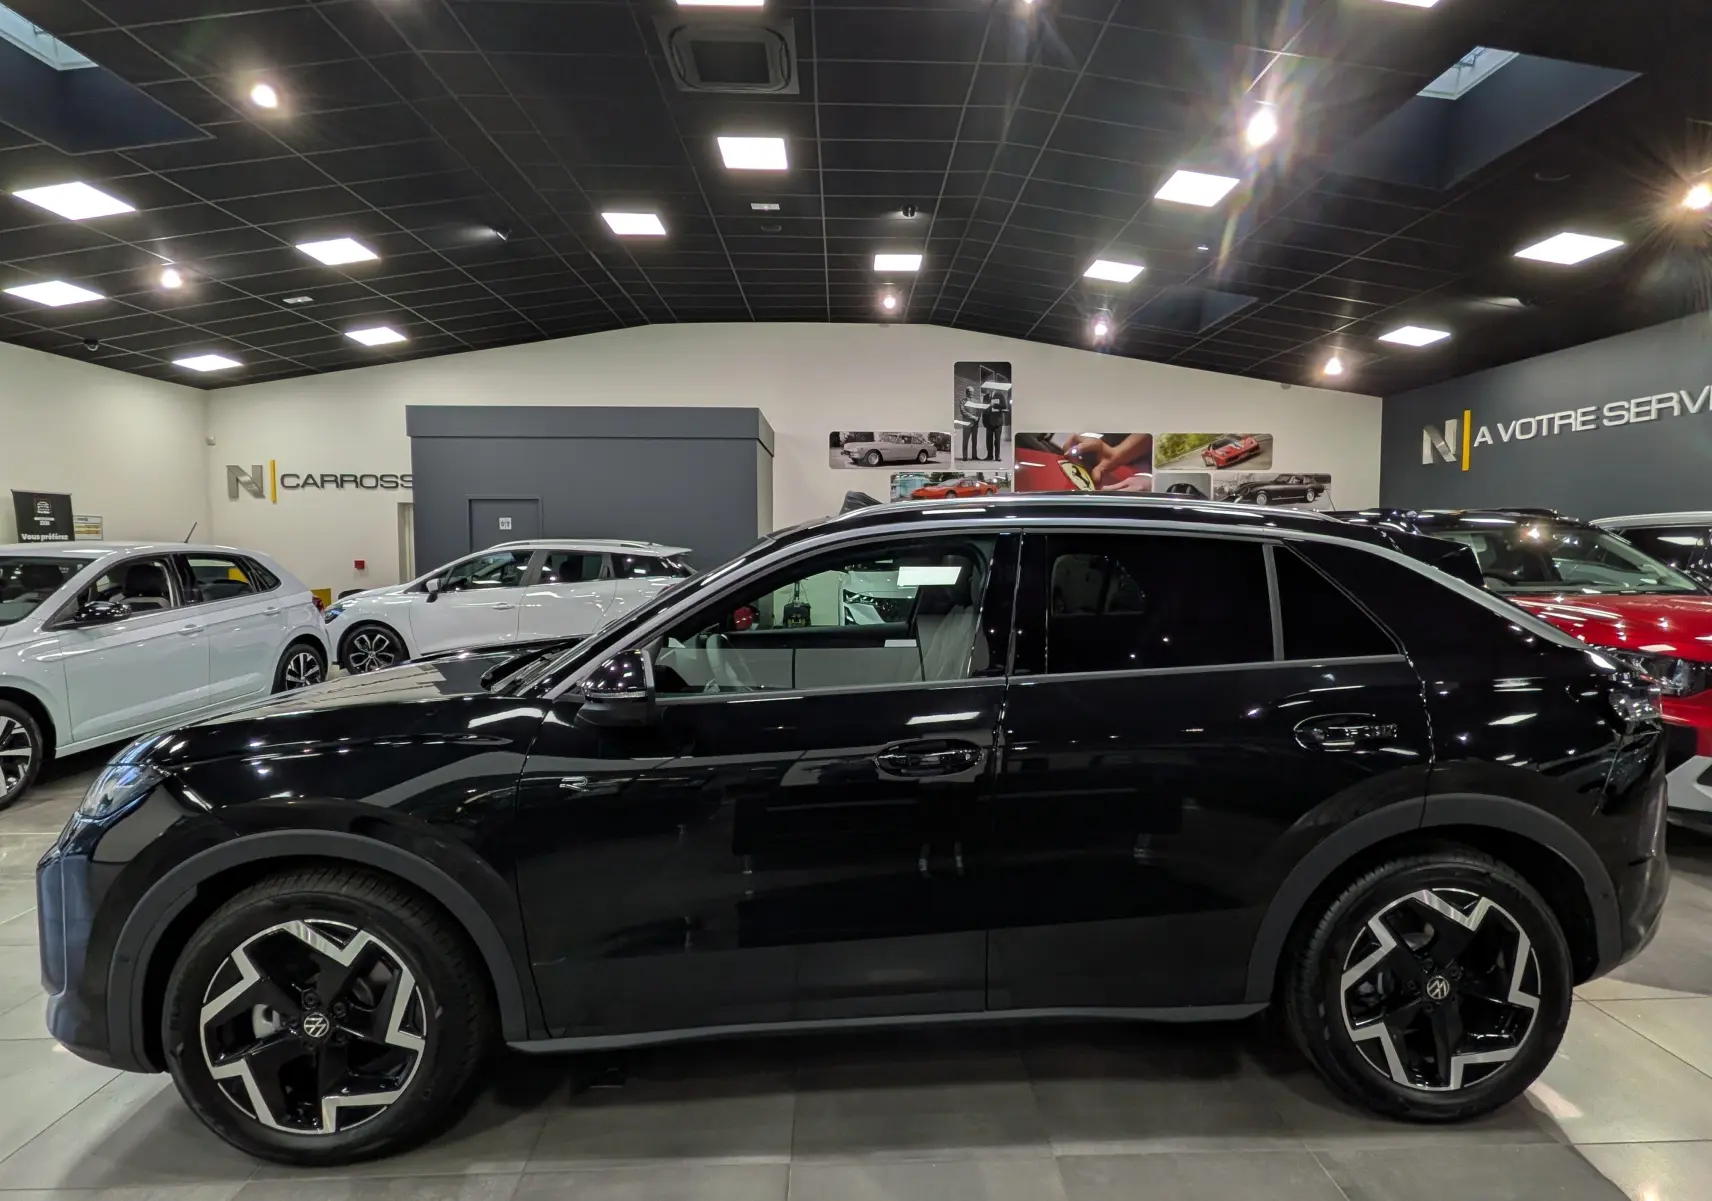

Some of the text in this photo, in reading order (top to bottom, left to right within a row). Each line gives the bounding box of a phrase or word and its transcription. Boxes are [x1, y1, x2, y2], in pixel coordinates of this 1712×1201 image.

[1422, 419, 1457, 465] N
[1473, 426, 1493, 447] A
[1497, 406, 1597, 443] VOTRE
[226, 465, 266, 500] N
[21, 533, 40, 541] Vous
